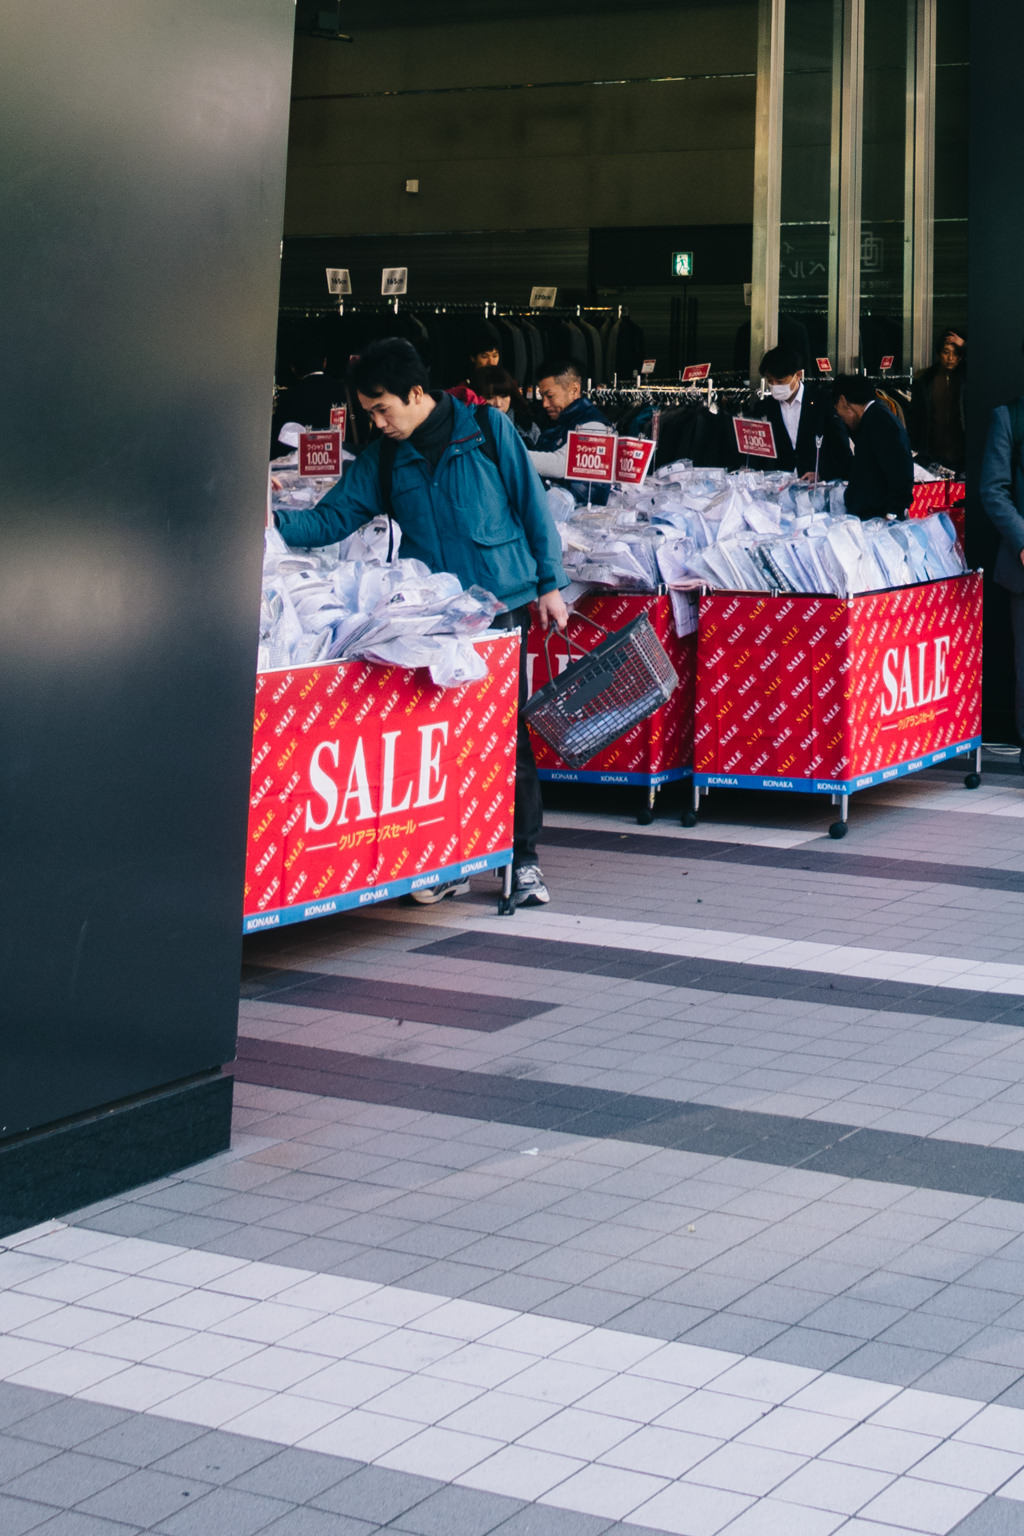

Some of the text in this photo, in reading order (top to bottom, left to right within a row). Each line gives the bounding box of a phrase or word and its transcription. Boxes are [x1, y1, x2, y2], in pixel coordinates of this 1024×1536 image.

[881, 635, 950, 717] SALE
[305, 721, 448, 833] SALE
[708, 777, 738, 785] KONAKA
[763, 780, 793, 788] KONAKA
[461, 859, 487, 874] KONAKA
[411, 874, 440, 889] KONAKA
[360, 888, 388, 903] KONAKA
[304, 901, 336, 917] KONAKA
[248, 915, 280, 930] KONAKA
